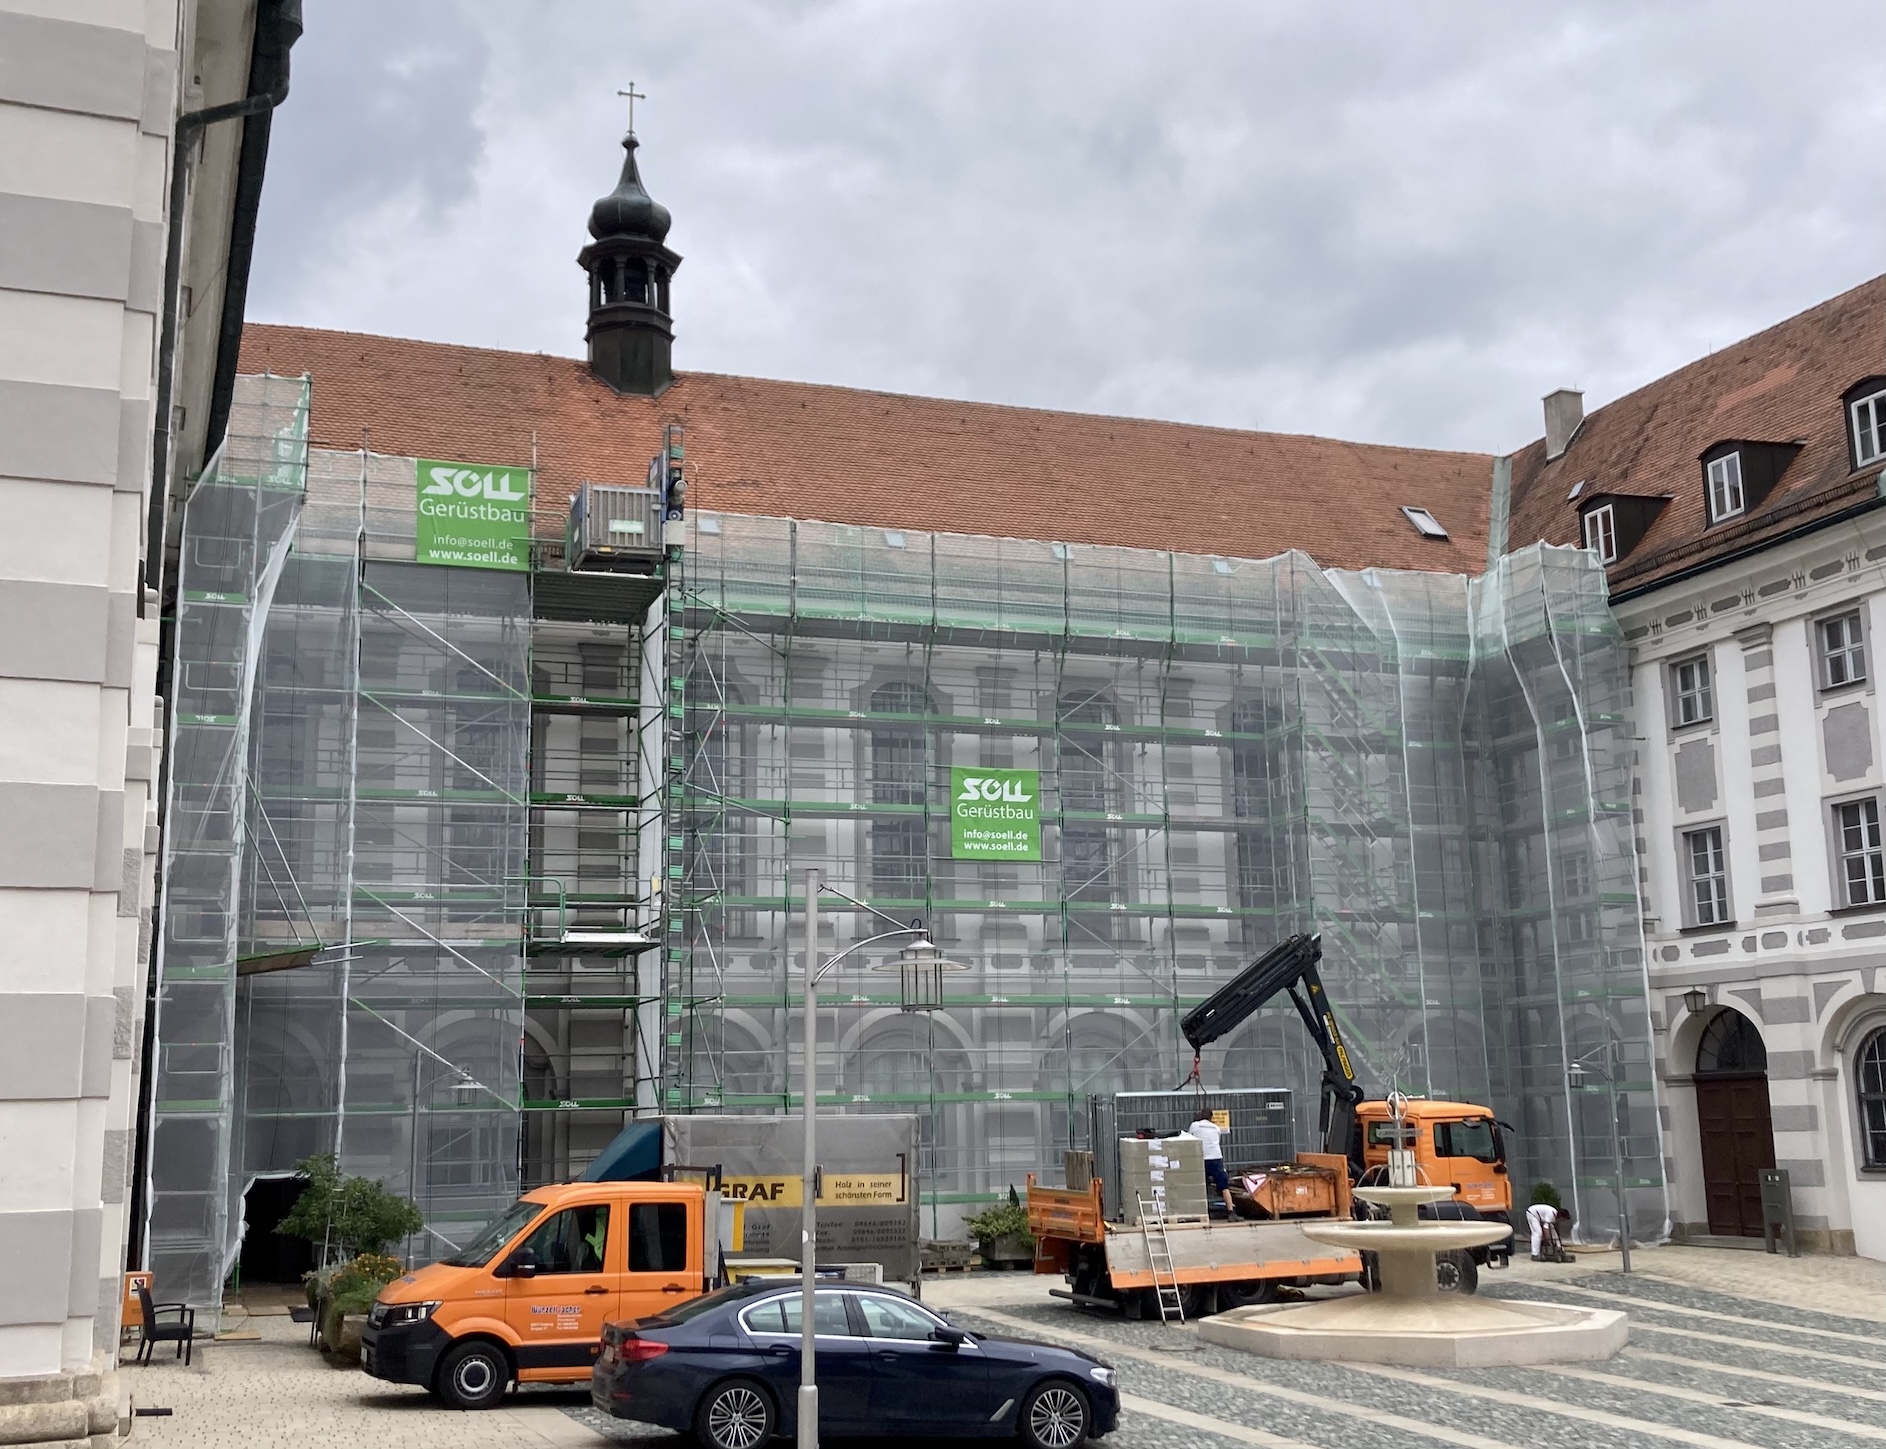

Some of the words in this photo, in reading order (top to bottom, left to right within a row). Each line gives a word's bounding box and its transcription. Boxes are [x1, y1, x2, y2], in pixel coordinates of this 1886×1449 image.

[419, 498, 525, 523] Gerüstbau
[433, 534, 514, 550] info@soell.de
[429, 549, 518, 565] www.soell.de
[957, 803, 1034, 819] Gerüstbau
[963, 828, 1028, 840] info@soell.de
[963, 841, 1029, 851] www.soell.de
[835, 1181, 852, 1189] Holz
[835, 1190, 872, 1199] schönsten
[873, 1190, 892, 1198] Form
